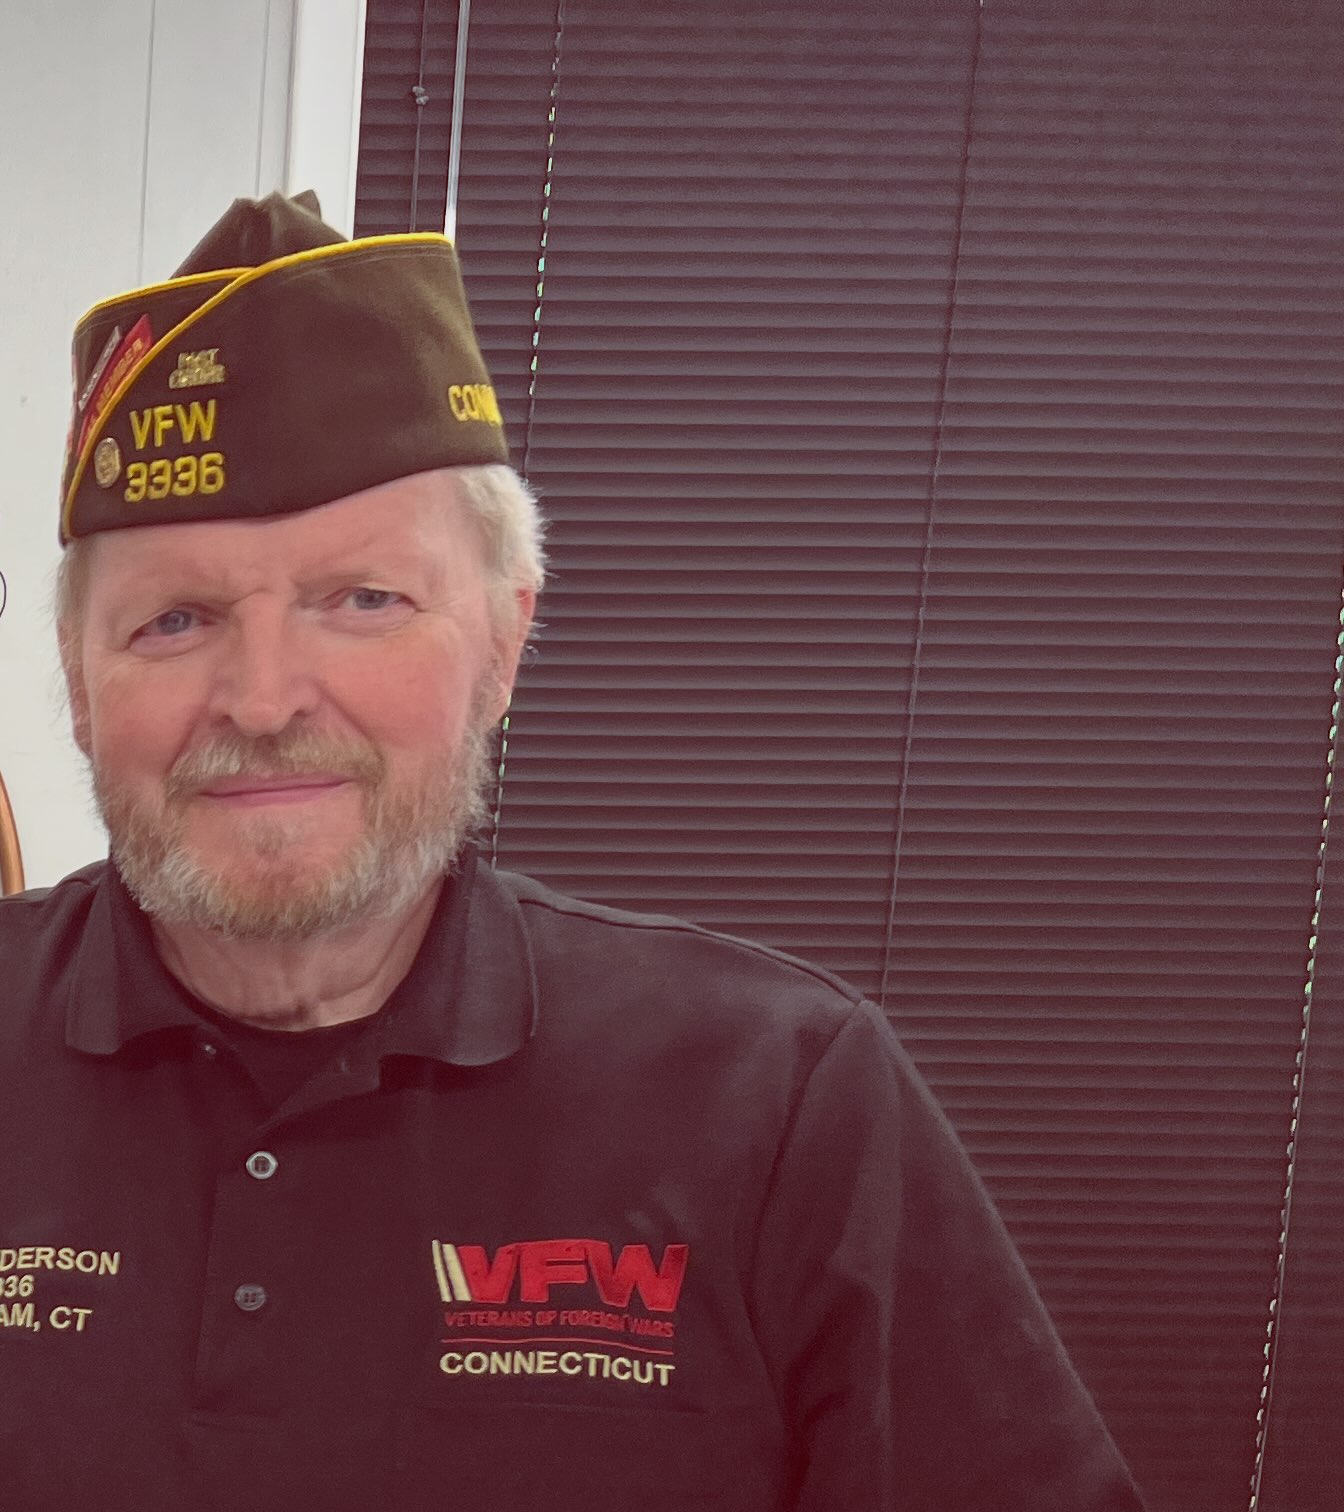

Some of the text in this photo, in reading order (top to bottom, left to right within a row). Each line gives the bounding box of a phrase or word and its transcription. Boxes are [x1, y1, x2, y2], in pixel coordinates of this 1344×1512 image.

[129, 399, 217, 450] VFW
[124, 452, 225, 501] 3336
[457, 1239, 689, 1313] VFW
[49, 1306, 93, 1332] CT
[444, 1310, 675, 1338] VETERANS OF FOREIGN WARS
[439, 1350, 676, 1387] CONNECTICUT
